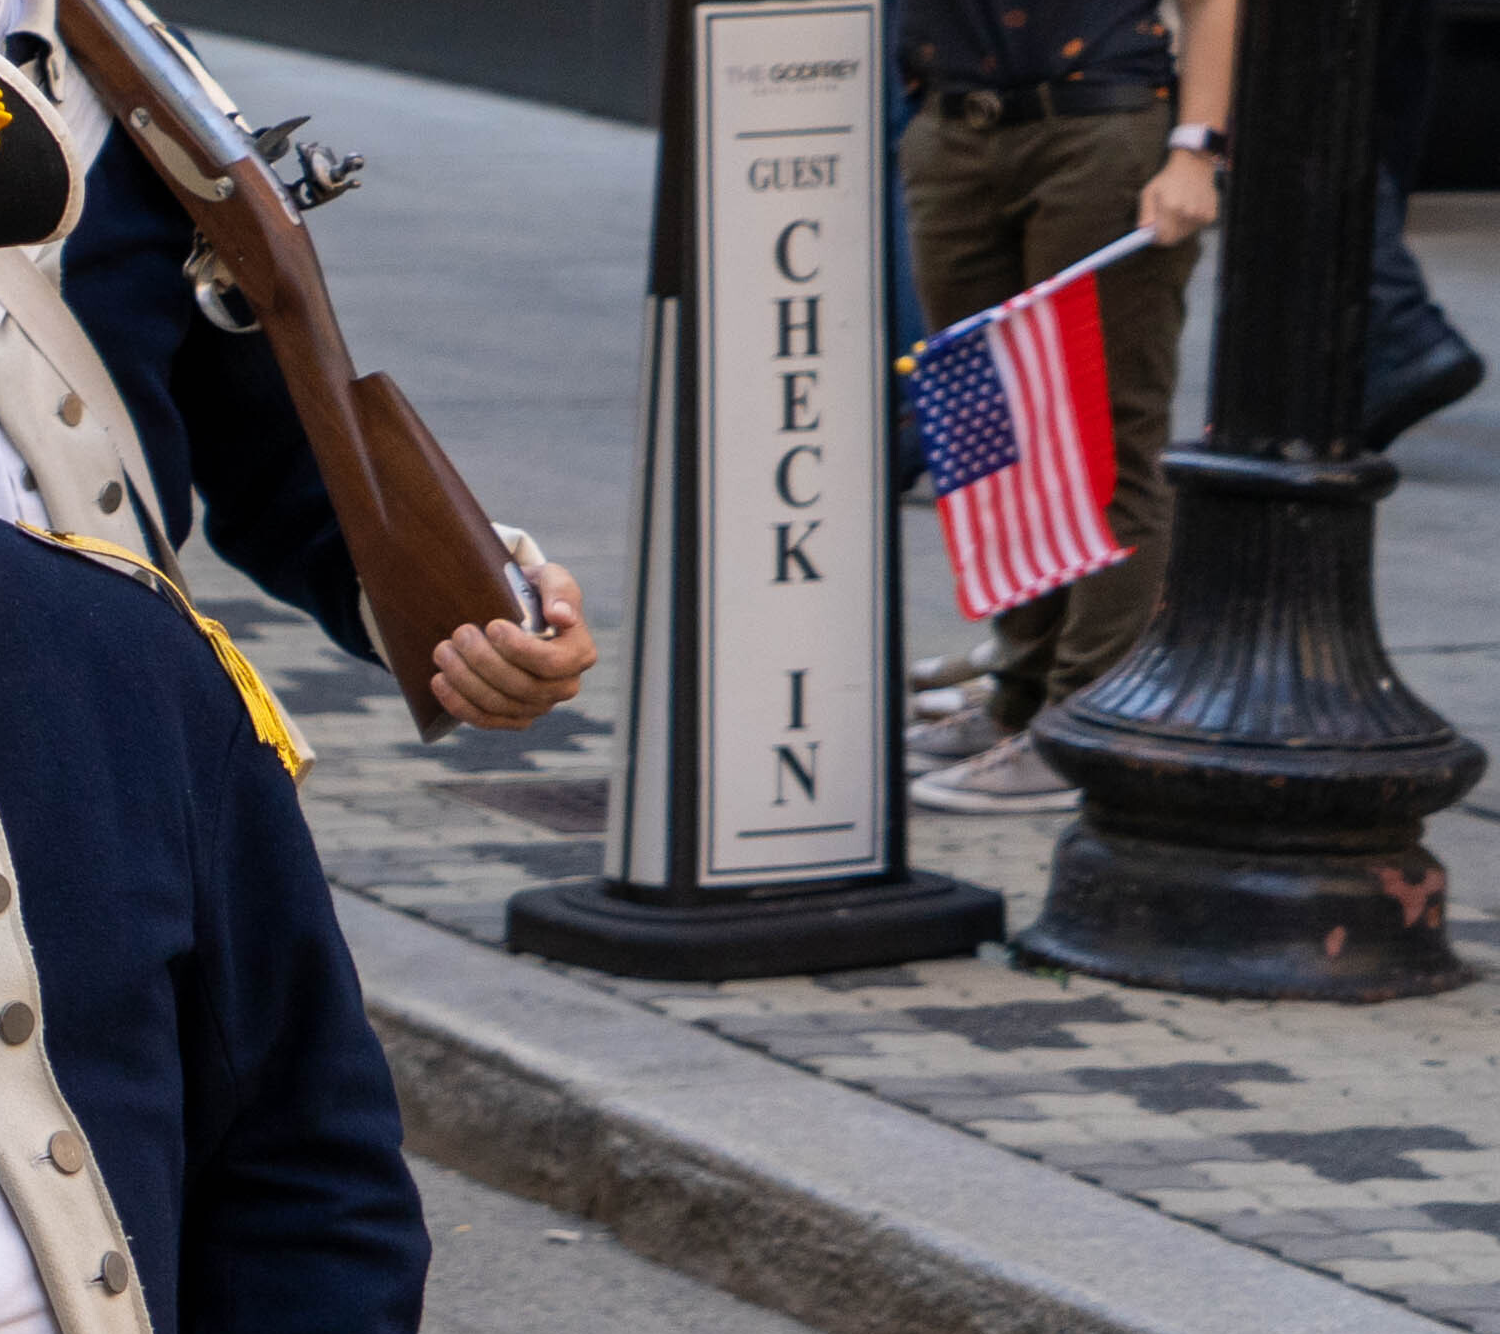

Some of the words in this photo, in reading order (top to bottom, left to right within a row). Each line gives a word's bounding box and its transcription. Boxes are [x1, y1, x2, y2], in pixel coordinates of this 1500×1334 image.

[749, 154, 839, 192] GUEST
[771, 218, 823, 585] CHECK
[772, 669, 820, 808] IN
